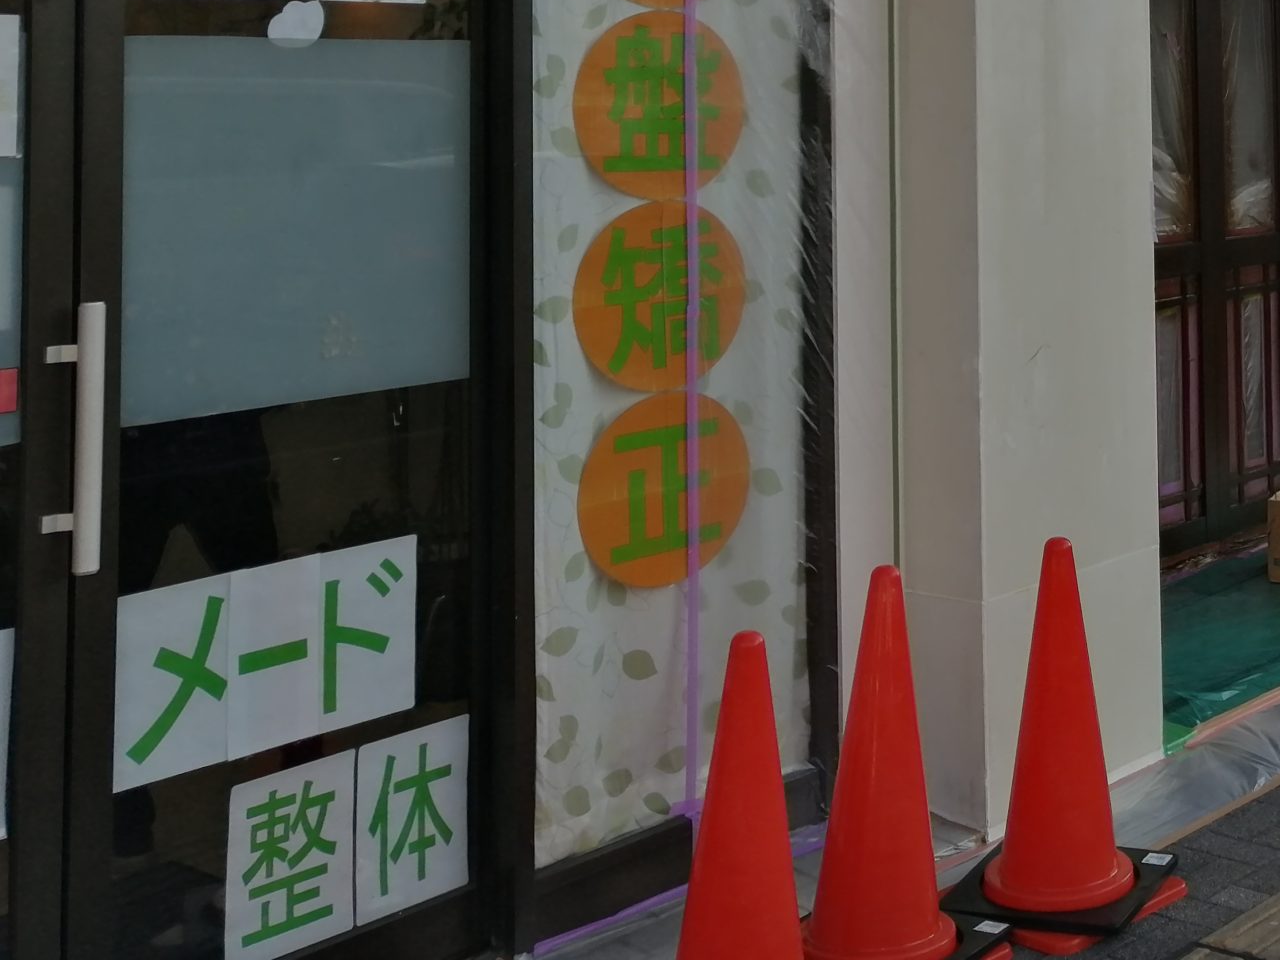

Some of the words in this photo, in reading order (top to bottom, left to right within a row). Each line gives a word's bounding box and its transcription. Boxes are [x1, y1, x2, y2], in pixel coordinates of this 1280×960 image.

[125, 557, 405, 766] メード
[240, 742, 454, 949] 整体
